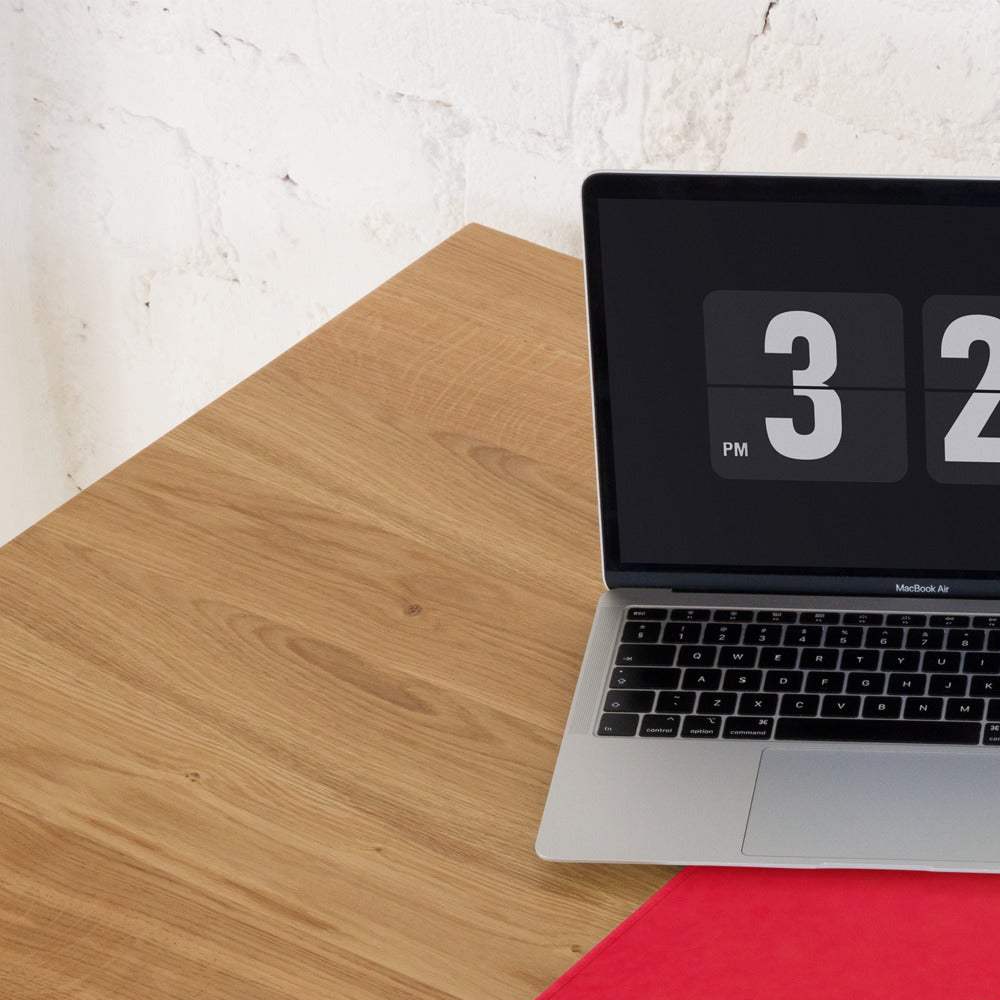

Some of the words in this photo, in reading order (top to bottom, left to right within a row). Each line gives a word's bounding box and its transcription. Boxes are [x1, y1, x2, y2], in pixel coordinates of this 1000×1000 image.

[764, 310, 842, 461] 3
[723, 442, 749, 456] PM
[895, 583, 937, 593] MacBook
[937, 584, 950, 593] Air
